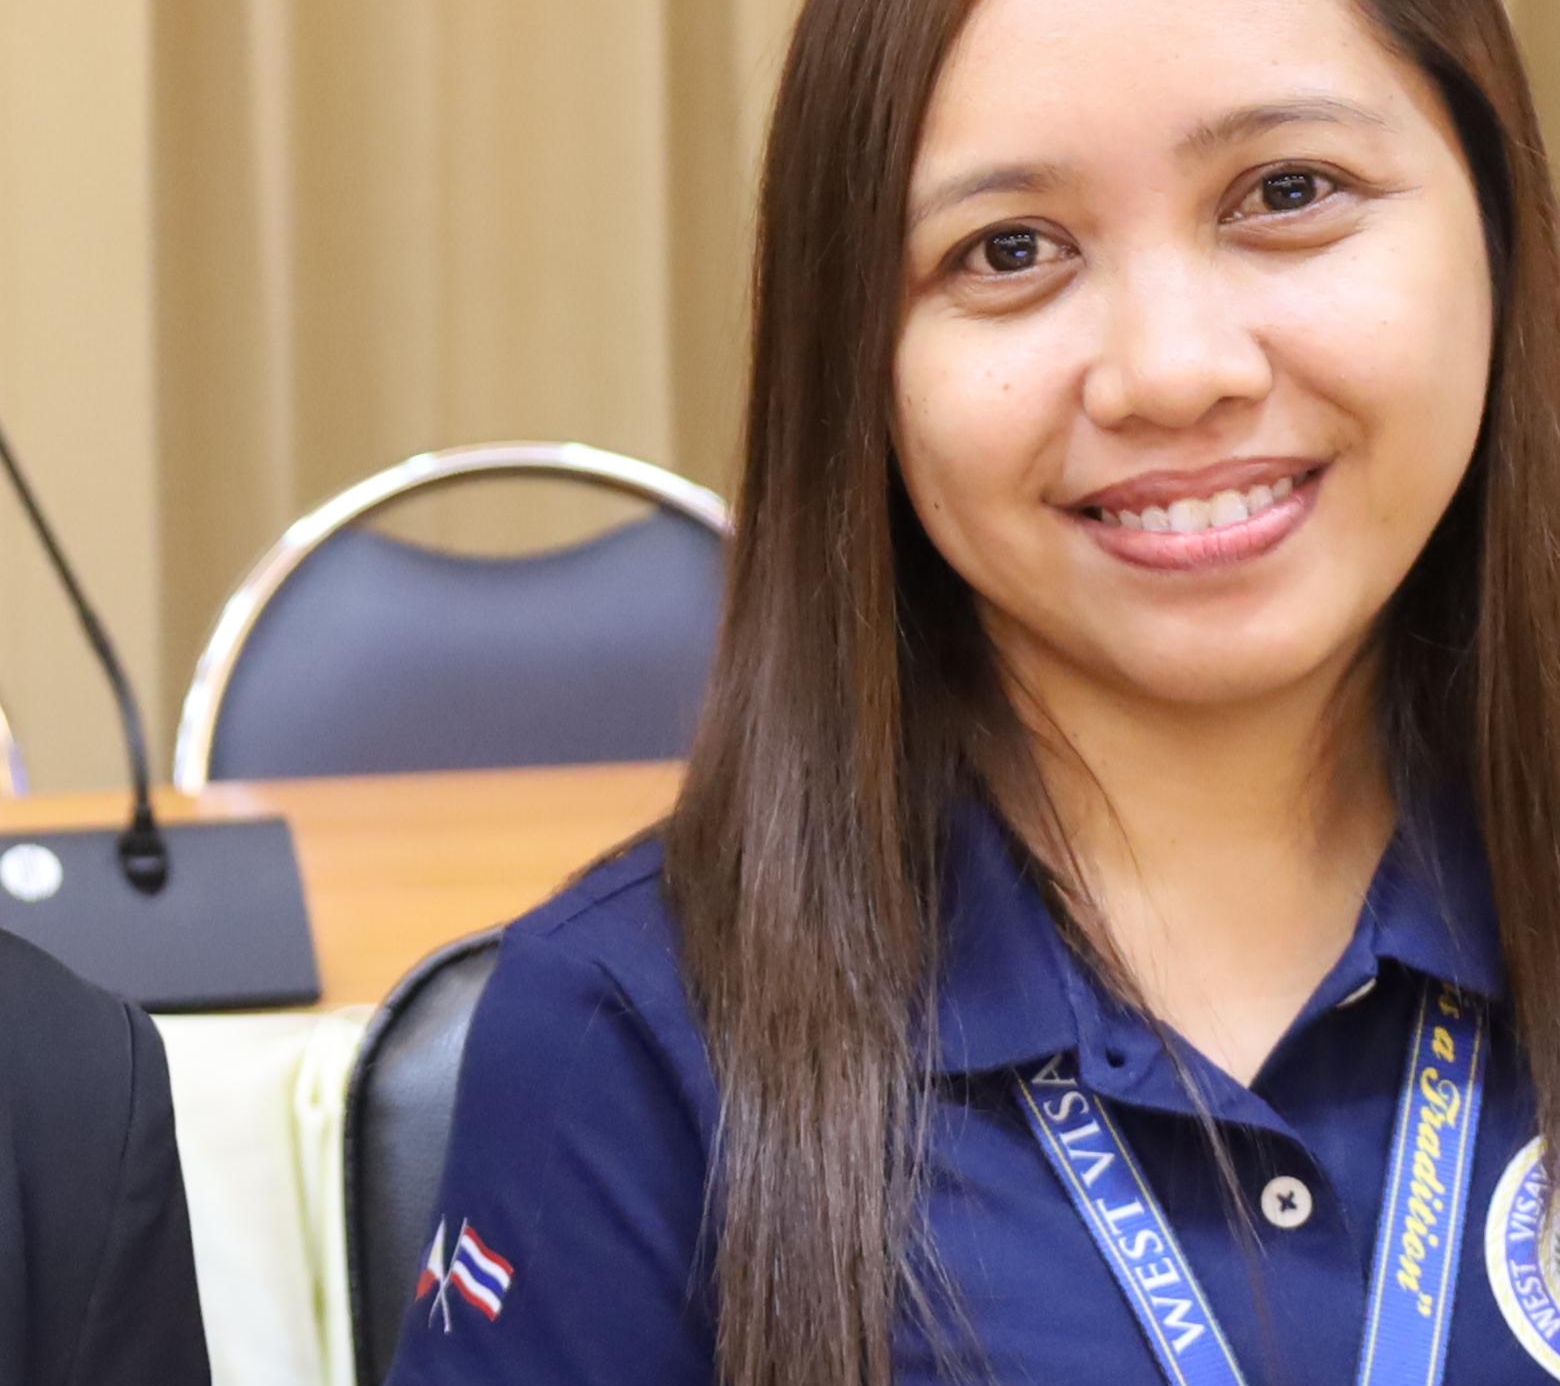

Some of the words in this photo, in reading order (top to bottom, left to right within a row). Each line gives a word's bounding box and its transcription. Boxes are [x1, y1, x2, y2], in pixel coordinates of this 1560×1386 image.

[1432, 1026, 1456, 1063] a
[1031, 1053, 1116, 1189] VISA
[1095, 1196, 1207, 1355] WEST
